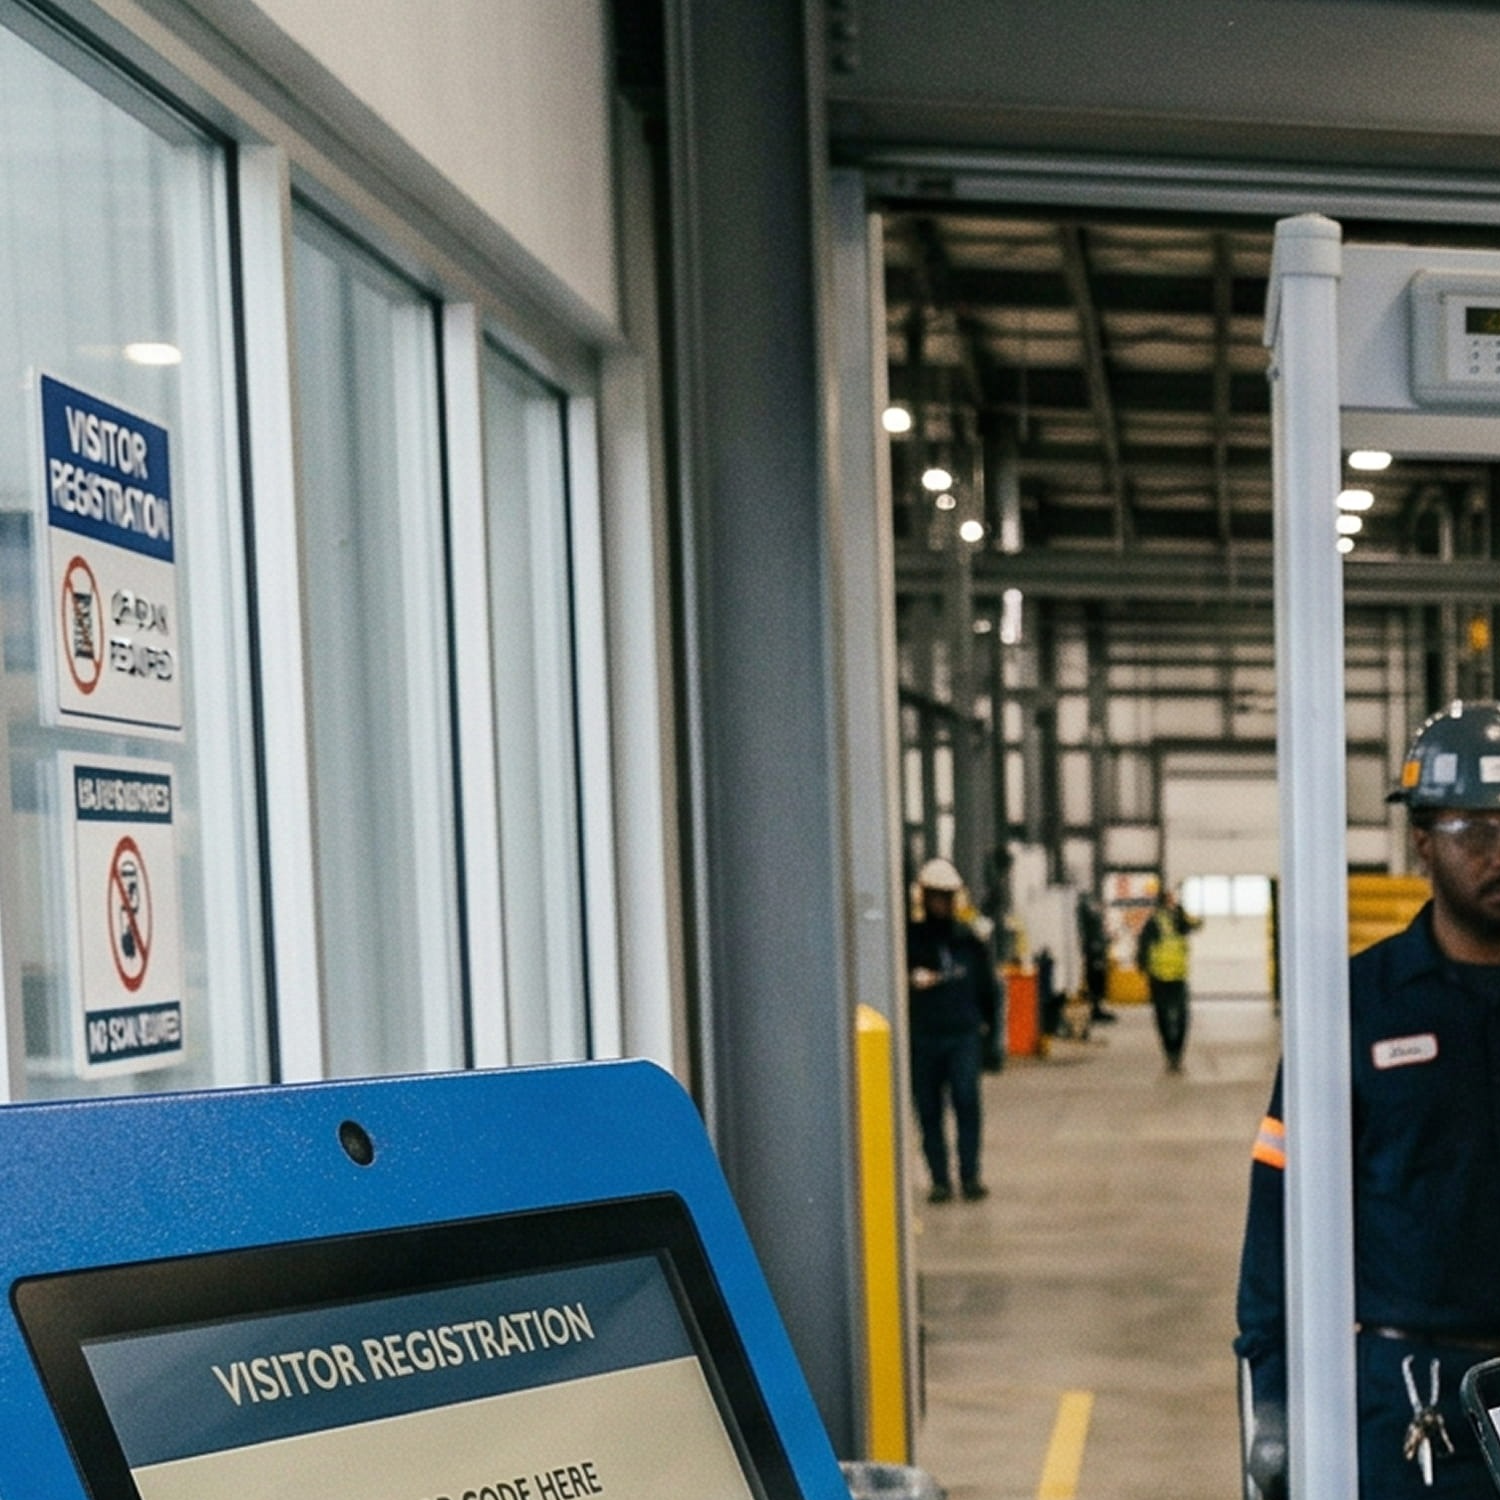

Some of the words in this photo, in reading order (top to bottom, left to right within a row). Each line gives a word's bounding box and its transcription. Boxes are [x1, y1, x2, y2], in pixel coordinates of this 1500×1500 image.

[65, 405, 148, 480] VISITOR
[212, 1343, 366, 1406] VISITOR
[361, 1302, 595, 1380] REGISTRATION
